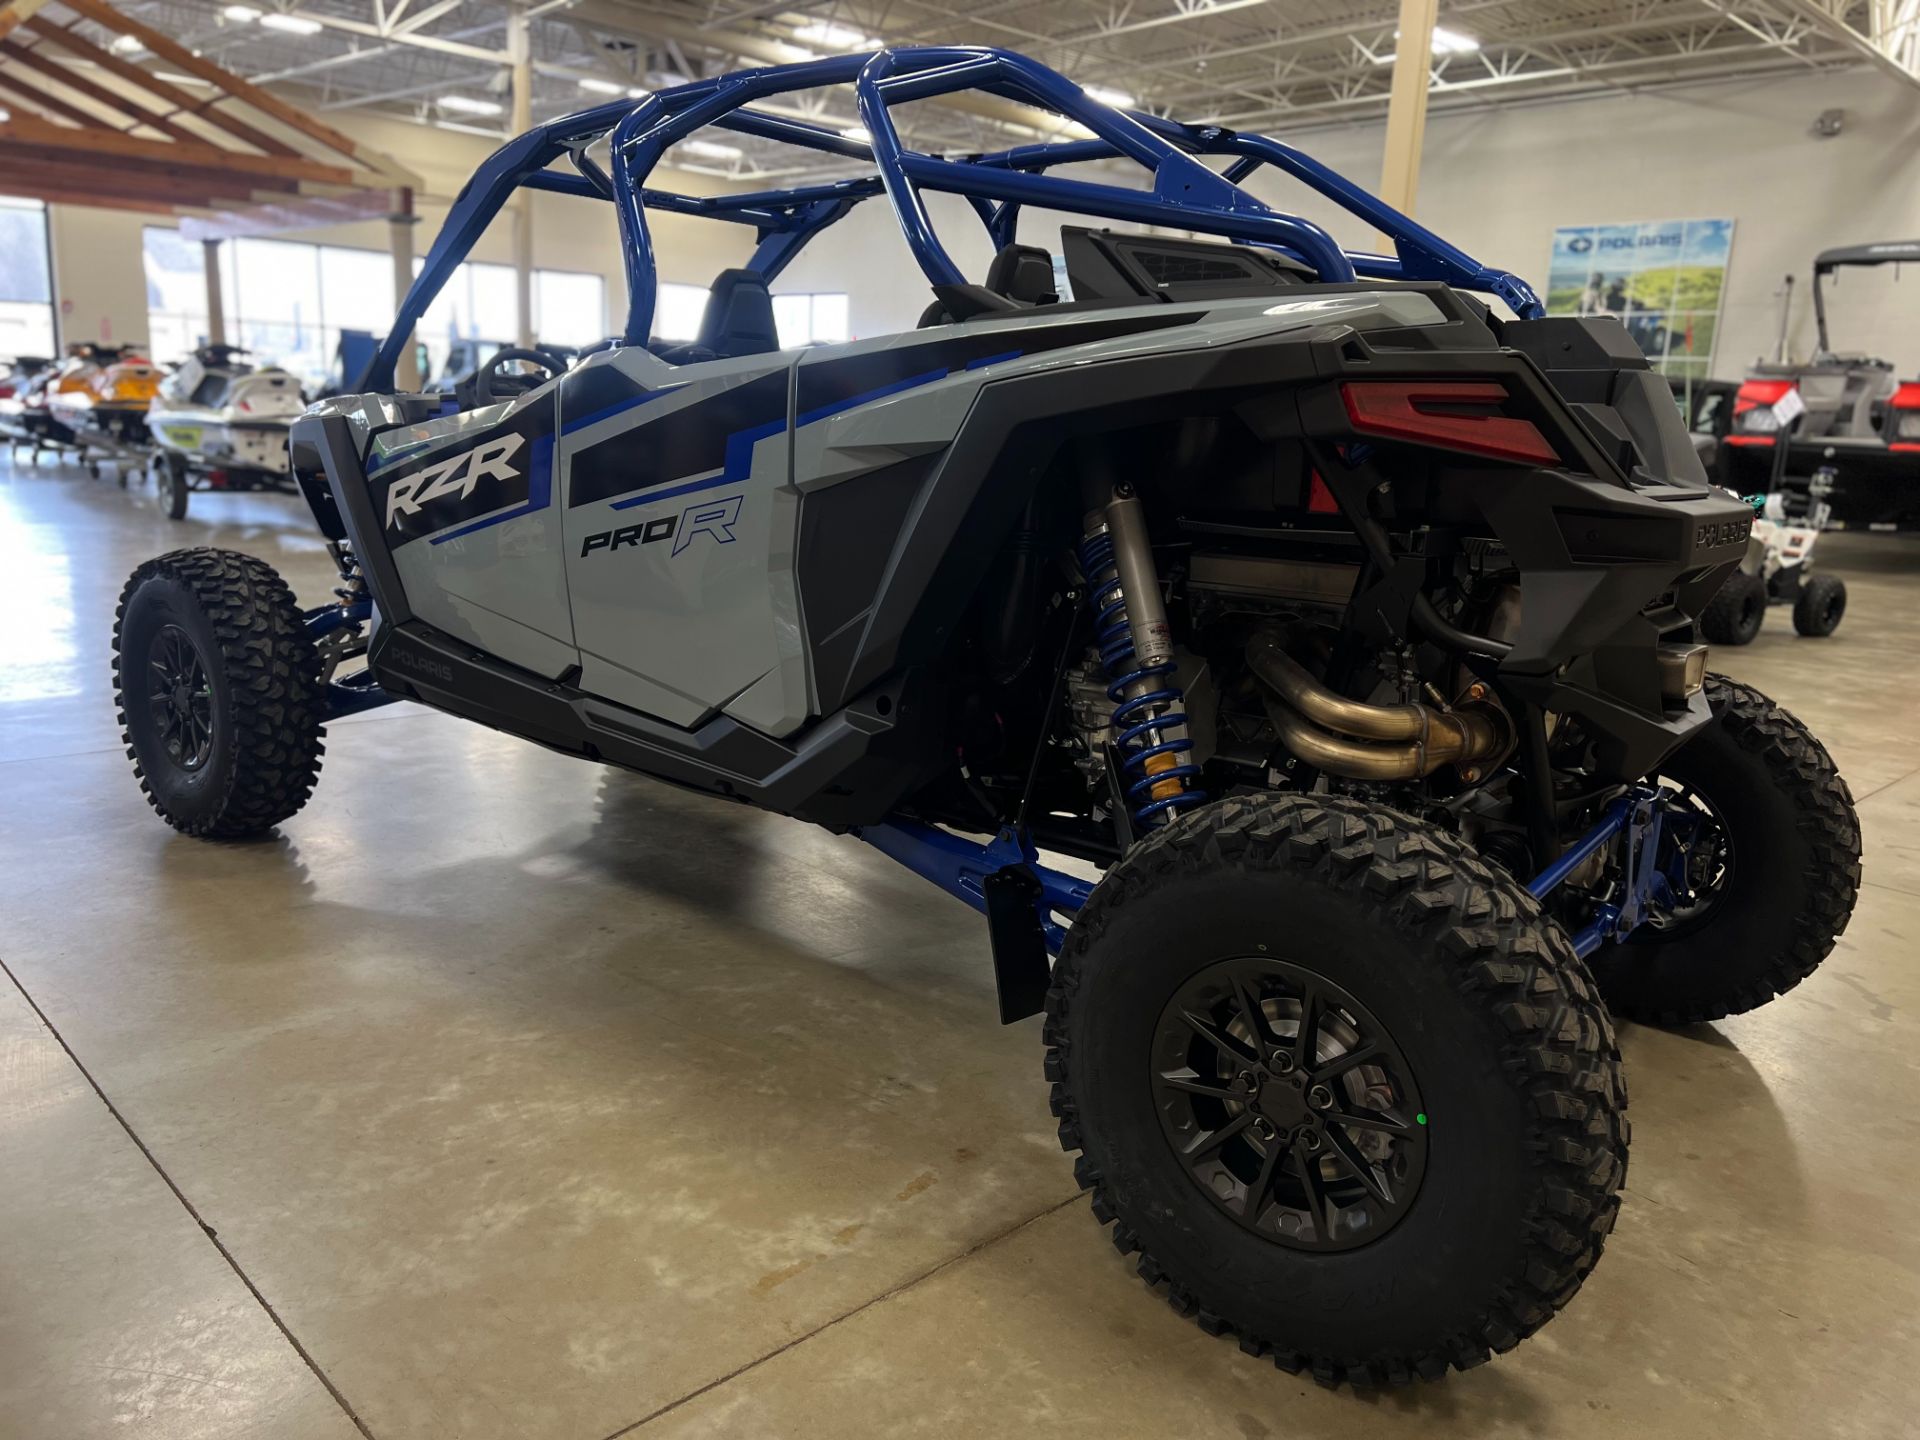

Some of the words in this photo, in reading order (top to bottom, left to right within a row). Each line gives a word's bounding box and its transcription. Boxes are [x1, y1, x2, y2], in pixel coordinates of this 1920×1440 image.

[1598, 232, 1683, 250] POLARIS
[386, 431, 525, 530] RZR
[580, 514, 678, 558] PRO
[671, 495, 744, 557] R
[1695, 519, 1749, 549] POLARIS
[392, 648, 453, 682] POLARIS
